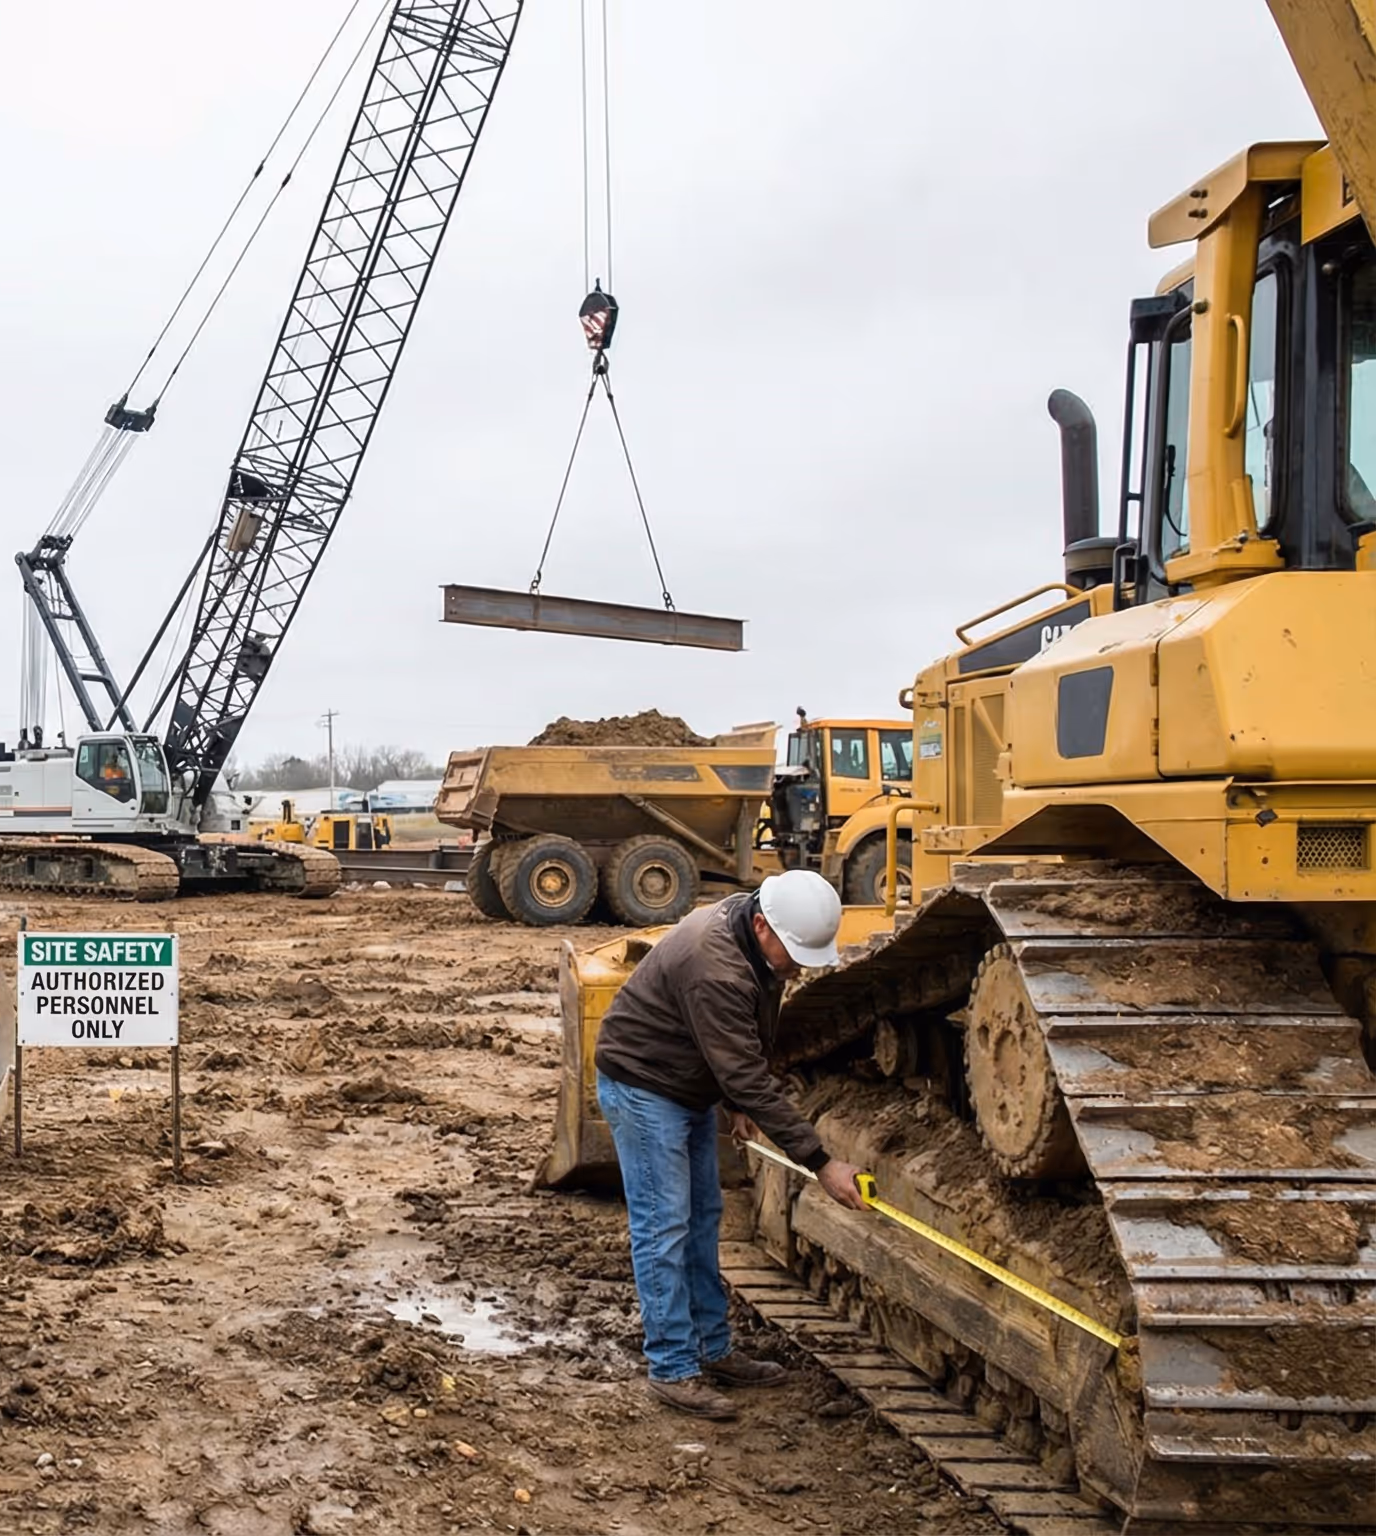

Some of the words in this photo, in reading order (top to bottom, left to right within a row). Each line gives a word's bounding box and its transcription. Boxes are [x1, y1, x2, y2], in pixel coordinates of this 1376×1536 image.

[31, 941, 77, 962] SITE
[84, 941, 164, 962] SAFETY
[31, 972, 164, 990] AUTHORIZED
[36, 996, 159, 1014] PERSONNEL
[72, 1020, 124, 1038] ONLY
